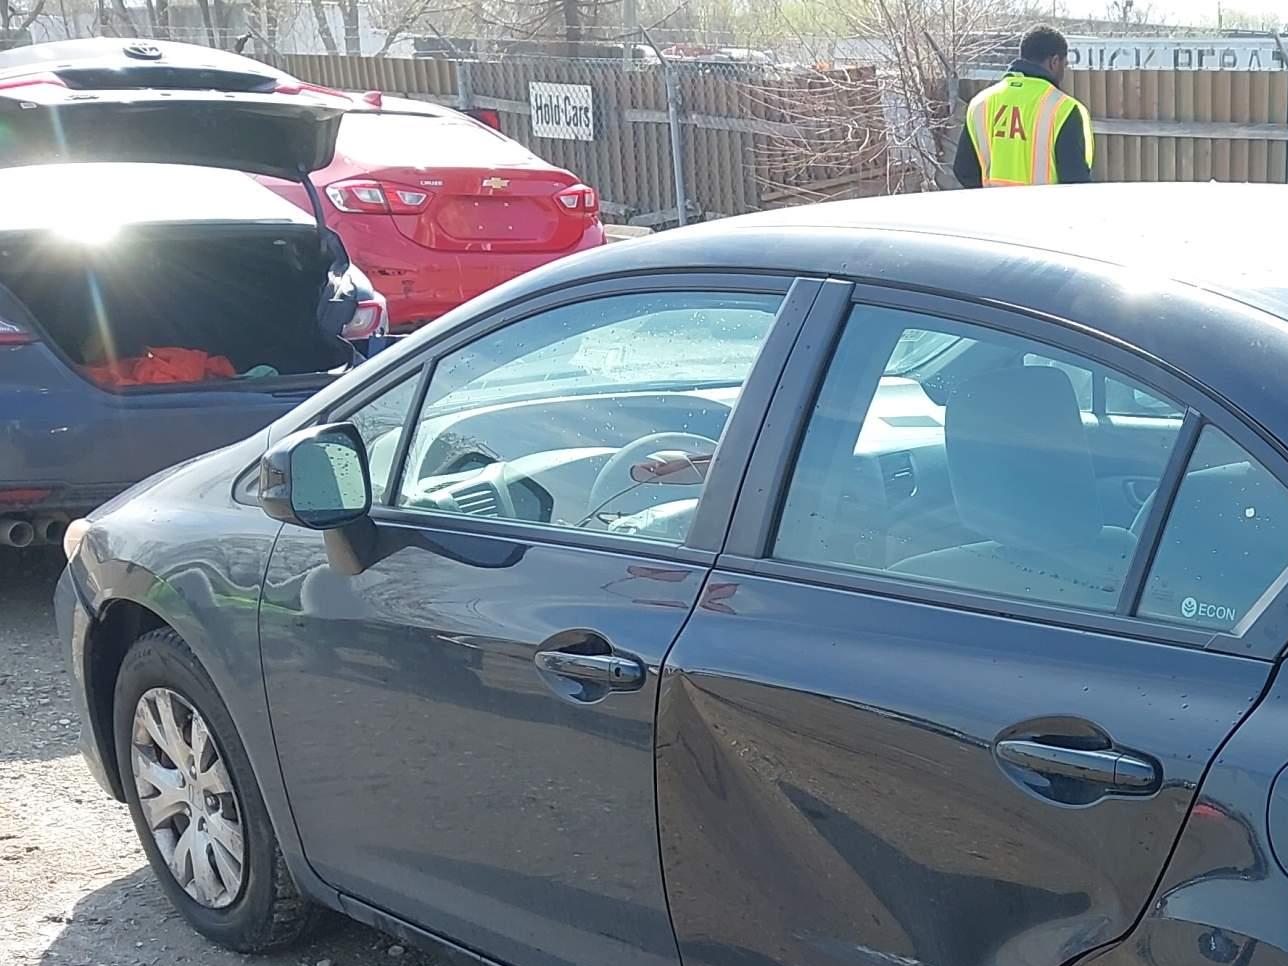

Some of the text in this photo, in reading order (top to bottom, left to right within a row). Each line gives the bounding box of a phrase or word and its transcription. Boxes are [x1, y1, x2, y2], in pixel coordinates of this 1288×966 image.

[535, 93, 590, 128] Hold Cars
[1199, 602, 1236, 621] ECON
